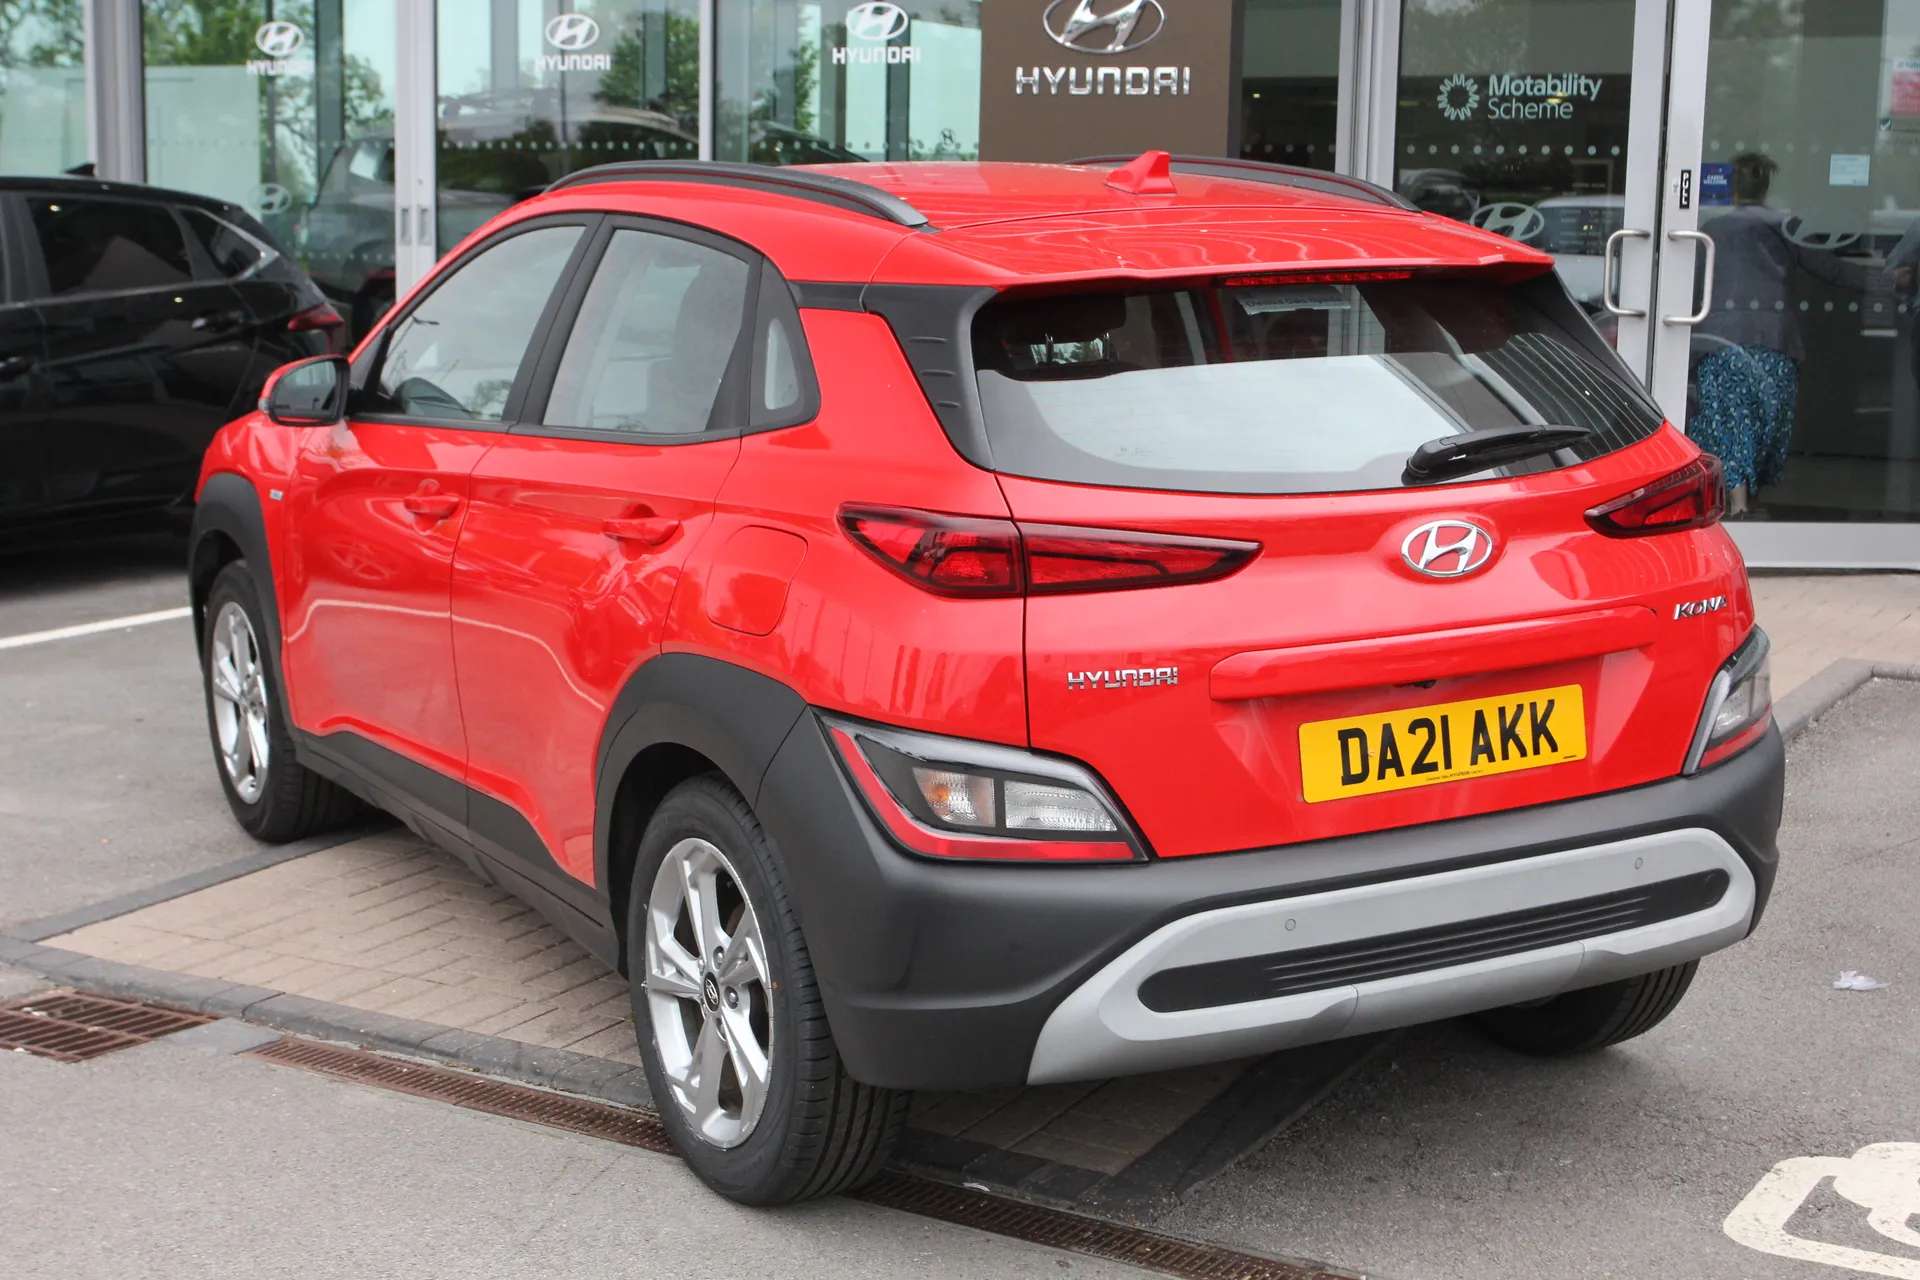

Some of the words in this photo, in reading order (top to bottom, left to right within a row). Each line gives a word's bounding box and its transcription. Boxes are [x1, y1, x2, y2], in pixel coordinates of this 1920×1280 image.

[535, 54, 611, 71] HYUNDAI
[832, 46, 921, 64] HYUNDAI
[1015, 66, 1191, 95] HYUNDAI
[1488, 72, 1602, 101] Motability
[1487, 98, 1573, 119] Scheme
[1672, 595, 1727, 620] KONA
[1067, 667, 1178, 690] HYUNDAI
[1338, 714, 1451, 786] DA21
[1470, 699, 1559, 766] AKK
